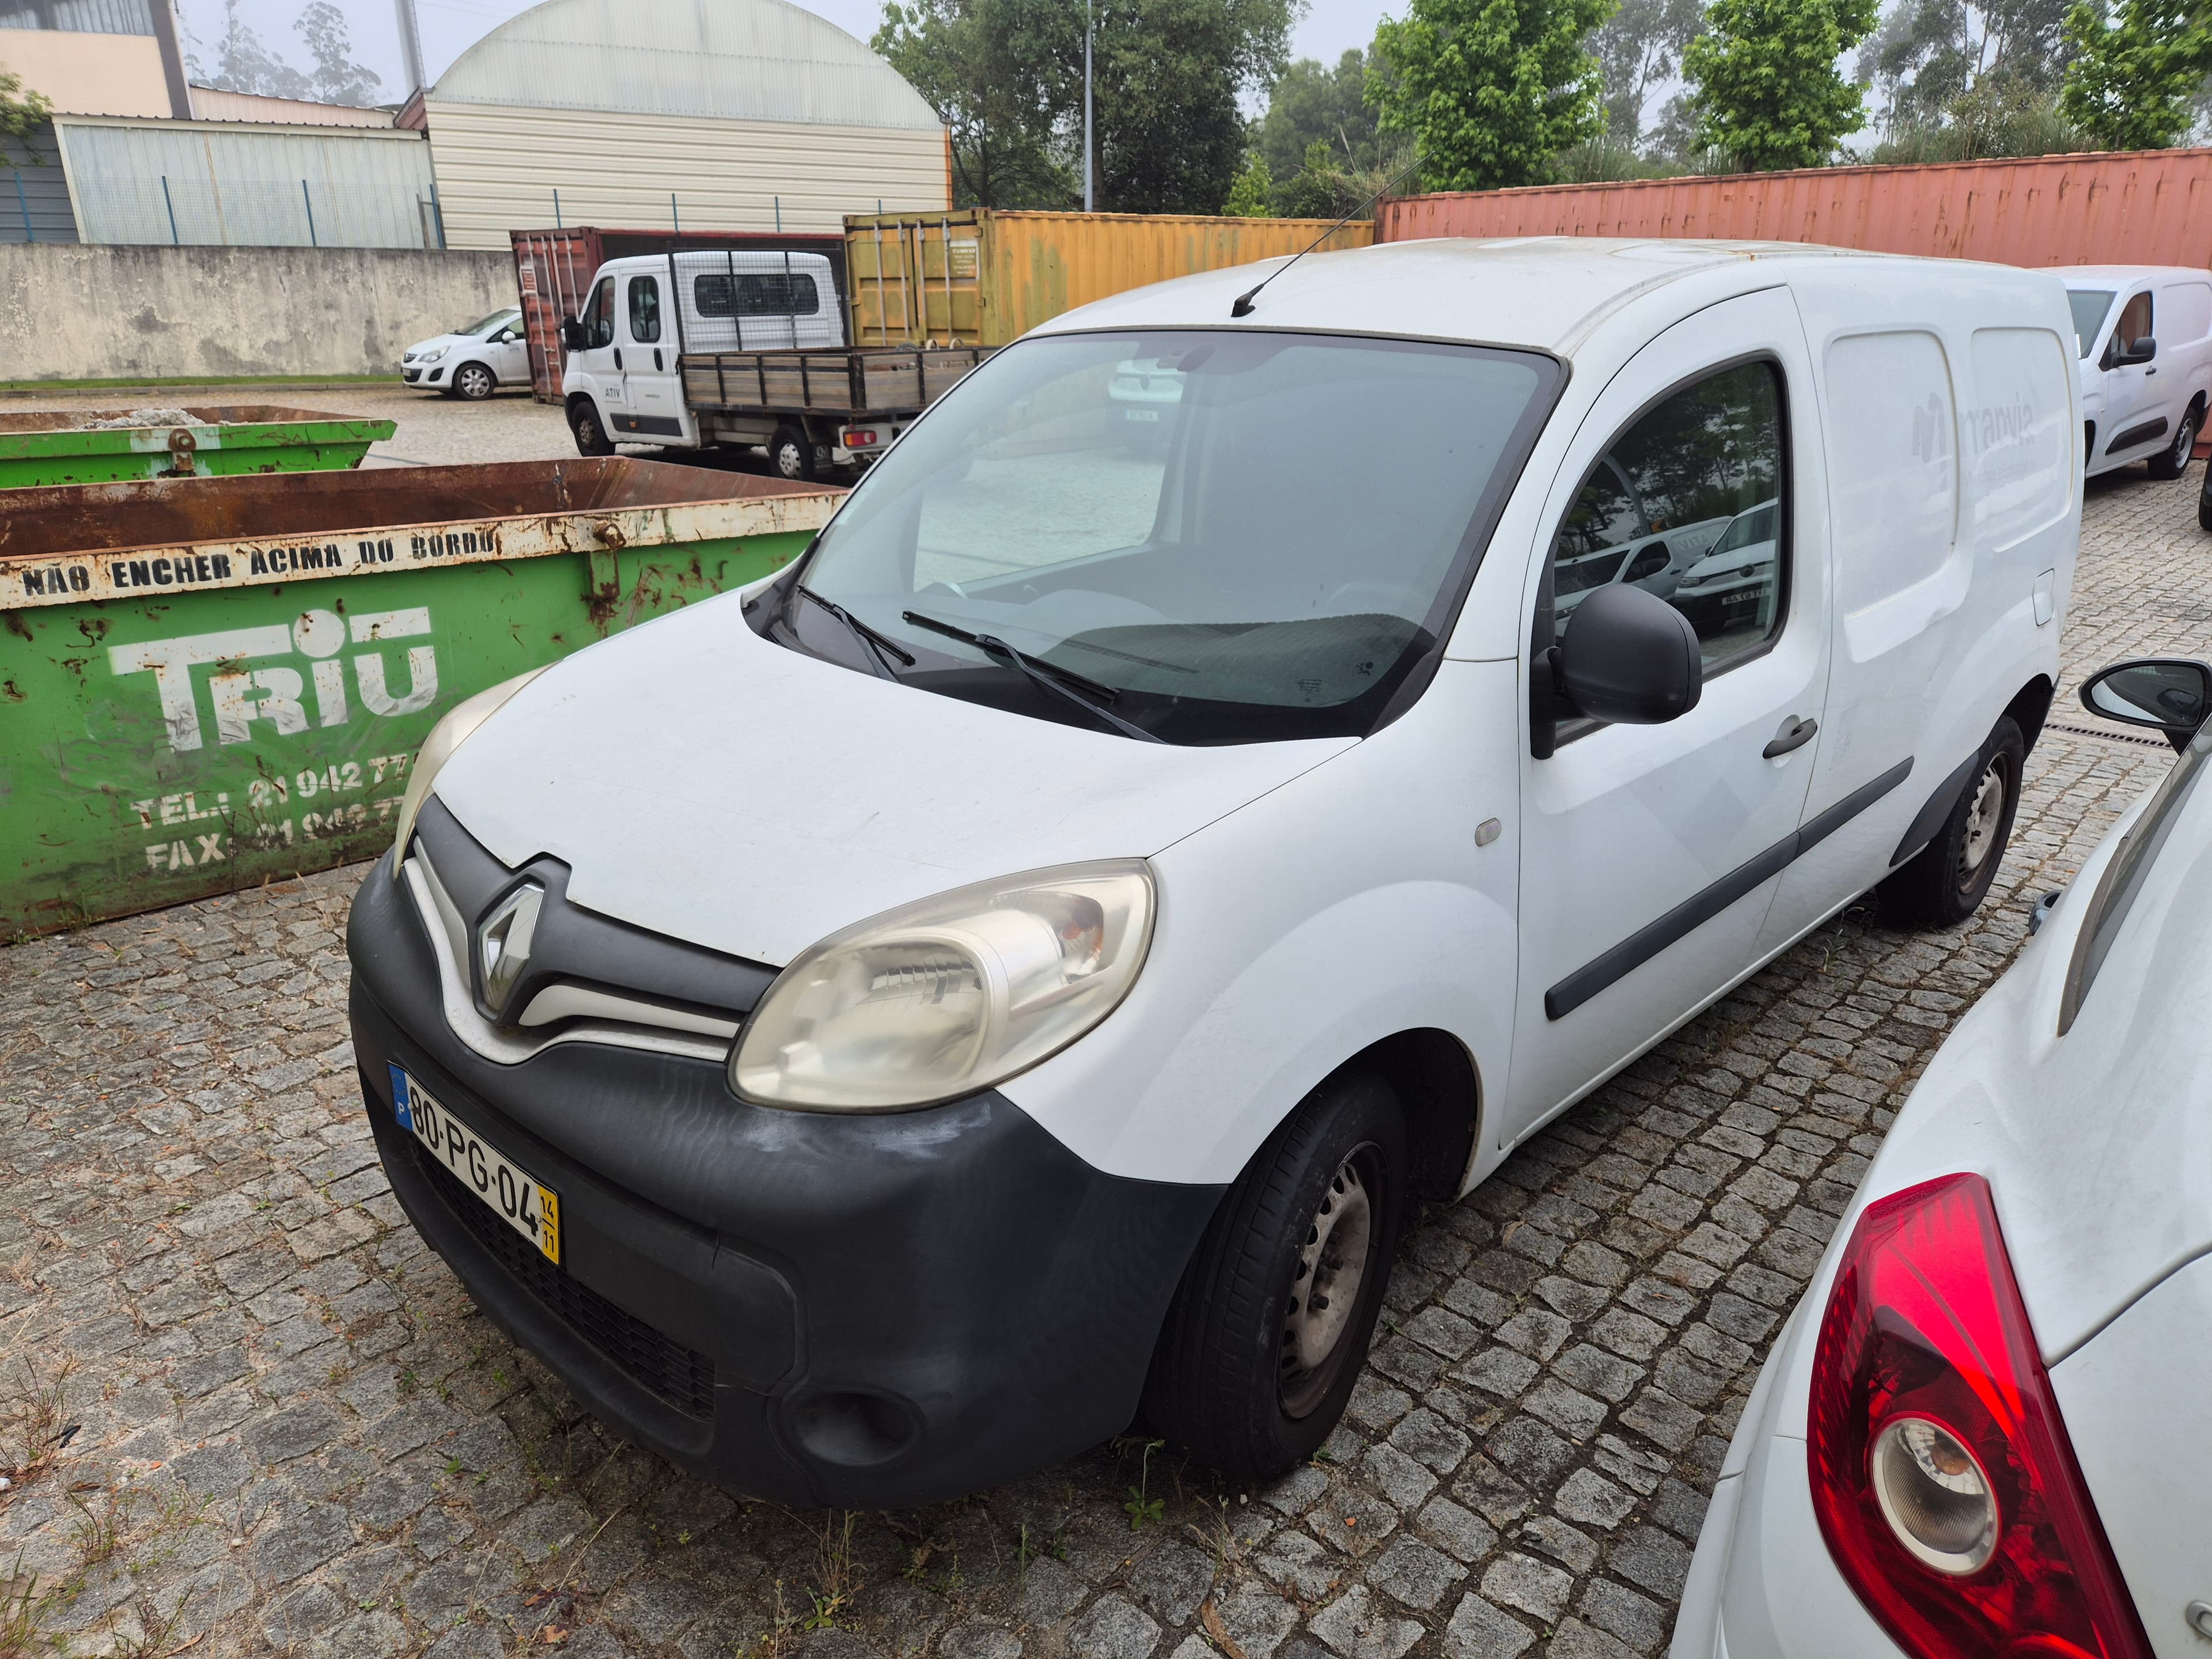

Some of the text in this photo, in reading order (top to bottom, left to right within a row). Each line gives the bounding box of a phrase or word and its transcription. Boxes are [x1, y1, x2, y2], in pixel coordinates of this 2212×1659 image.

[22, 529, 494, 596] NÃO ENCHER ACIMA DO BORDO
[248, 775, 289, 808] 21
[296, 761, 363, 798] 942
[397, 1103, 405, 1115] P
[540, 1195, 554, 1219] 14
[543, 1229, 554, 1253] 11
